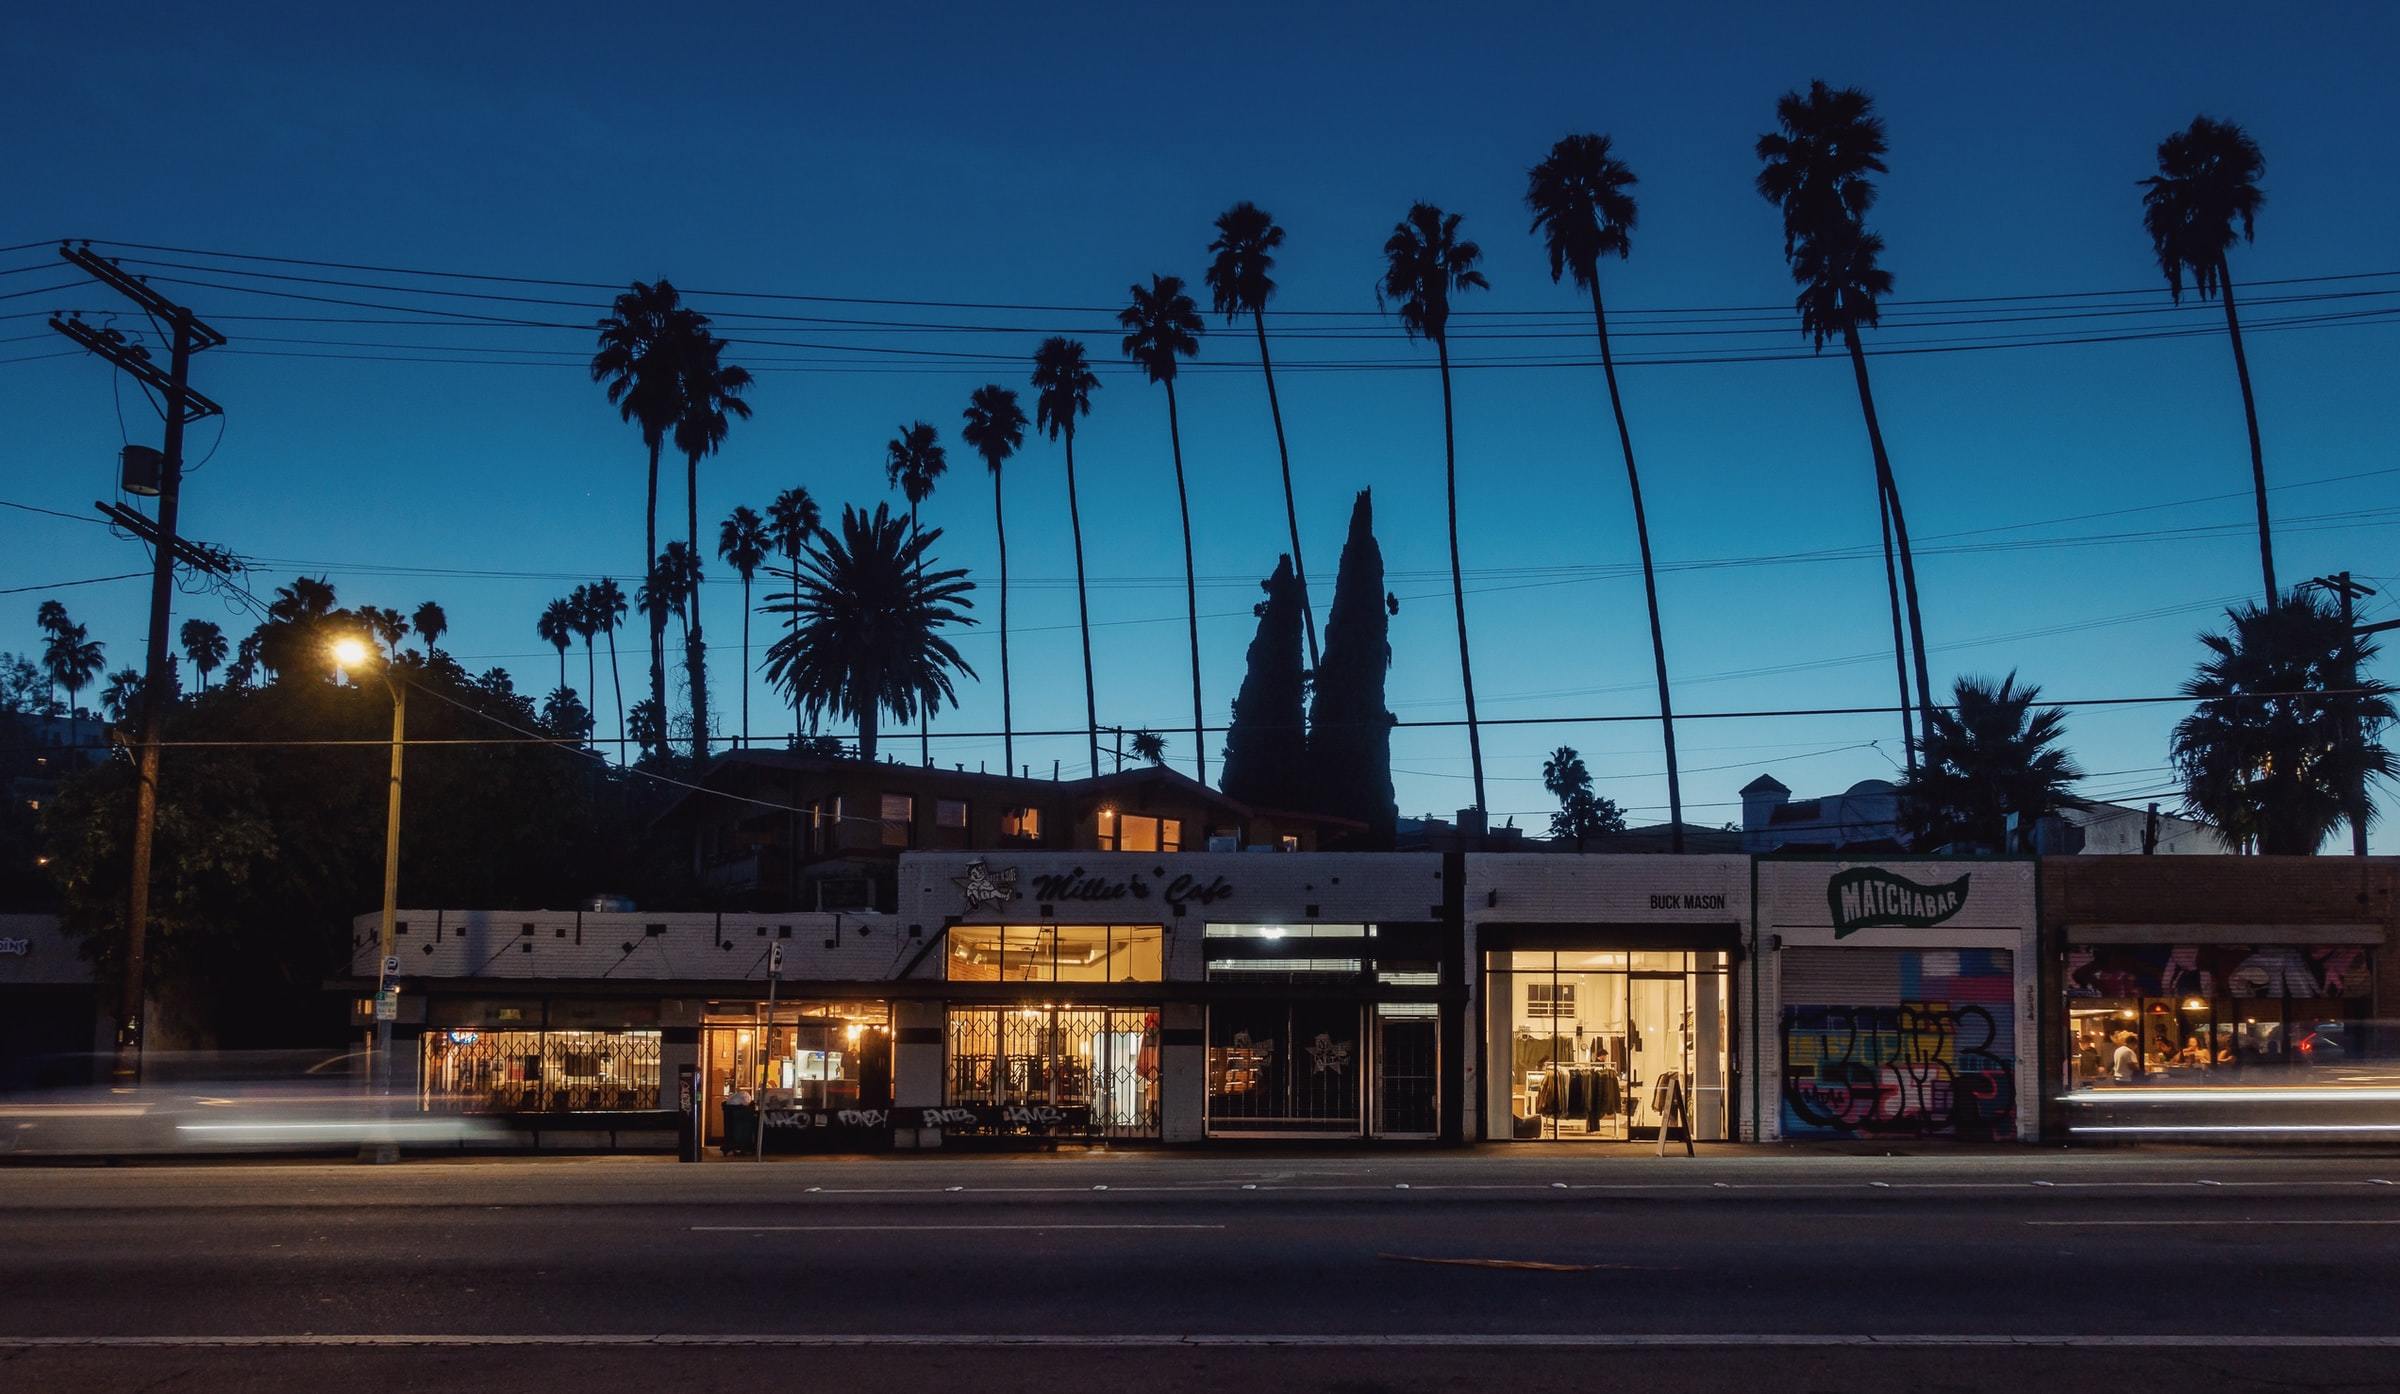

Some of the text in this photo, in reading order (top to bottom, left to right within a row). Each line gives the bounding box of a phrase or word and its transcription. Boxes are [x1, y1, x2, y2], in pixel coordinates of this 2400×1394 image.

[1162, 873, 1234, 905] Cafe
[1650, 895, 1725, 910] BUCK MASON
[1839, 879, 1958, 924] MATCHABAR
